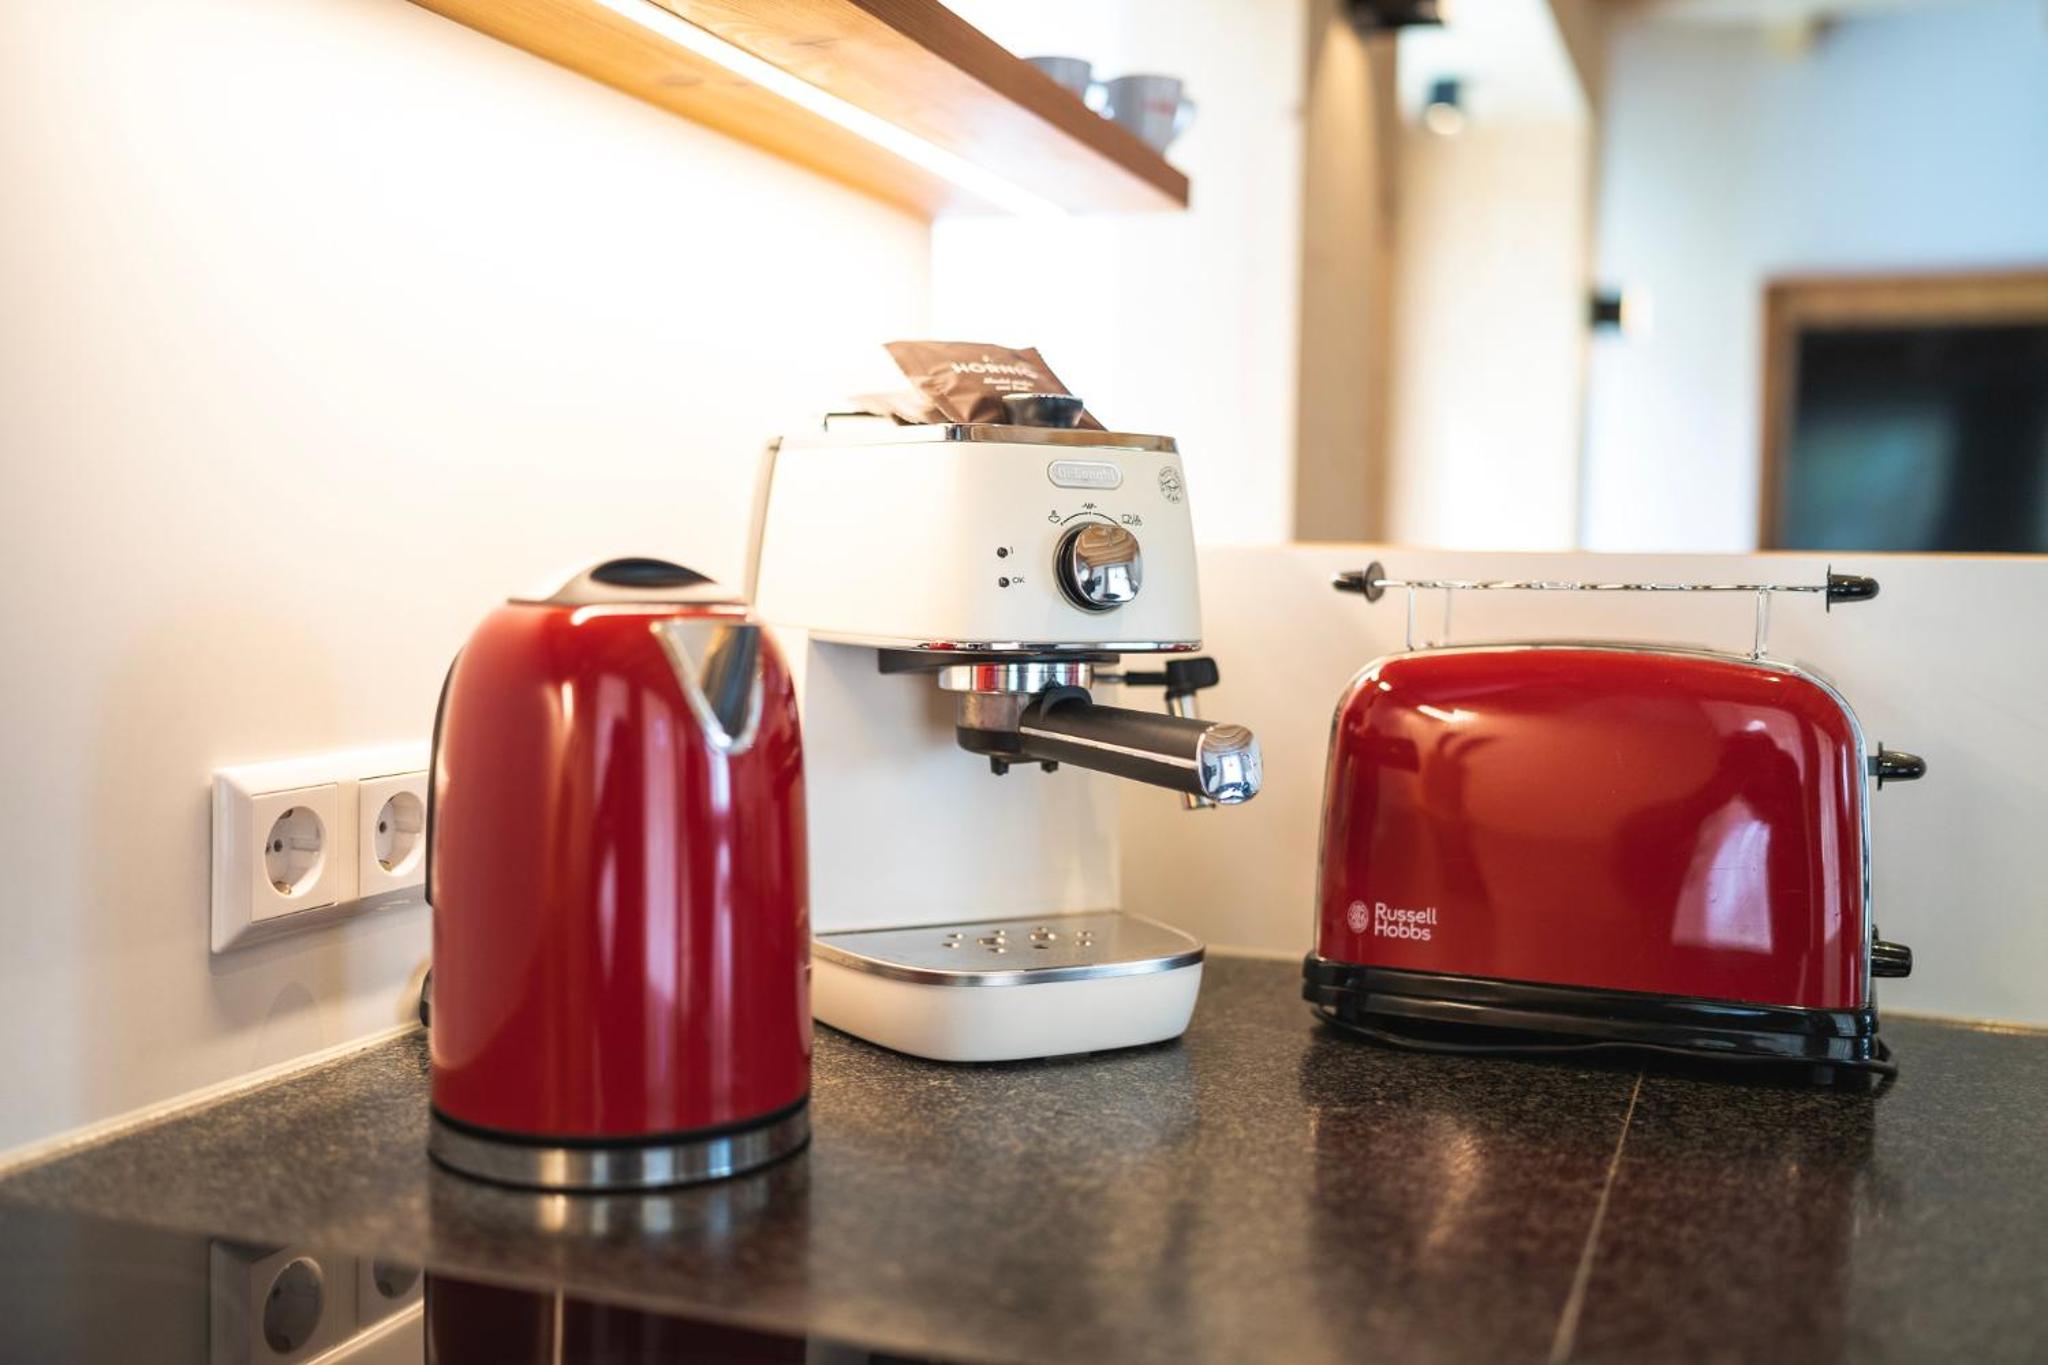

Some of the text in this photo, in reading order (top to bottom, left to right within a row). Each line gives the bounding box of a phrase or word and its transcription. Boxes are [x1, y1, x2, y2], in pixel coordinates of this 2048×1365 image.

[1011, 576, 1025, 584] OK
[1375, 902, 1437, 925] Russell
[1374, 920, 1431, 940] Hobbs
